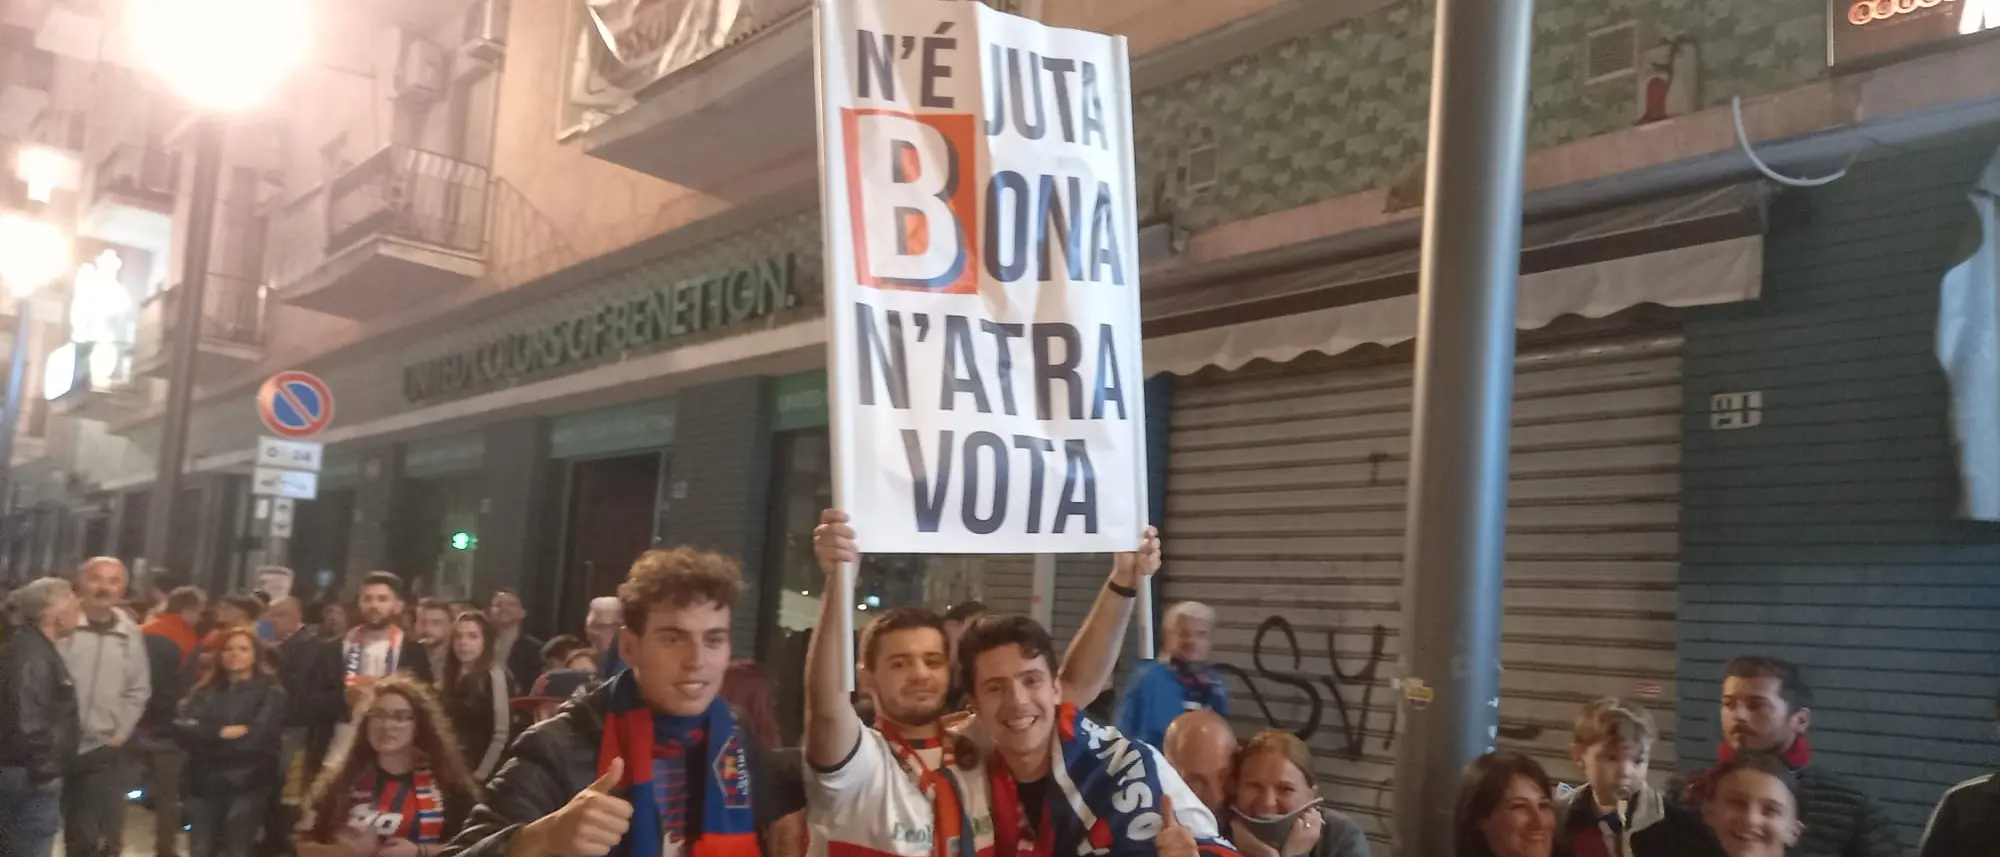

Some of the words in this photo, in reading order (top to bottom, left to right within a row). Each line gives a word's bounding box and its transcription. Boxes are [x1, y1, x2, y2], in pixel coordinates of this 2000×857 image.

[855, 21, 959, 109] N'É
[984, 43, 1109, 151] JUTA
[855, 112, 1127, 288] BONA
[474, 322, 570, 382] COLORS
[854, 301, 1128, 421] N'ATRA
[899, 429, 1099, 536] VOTA
